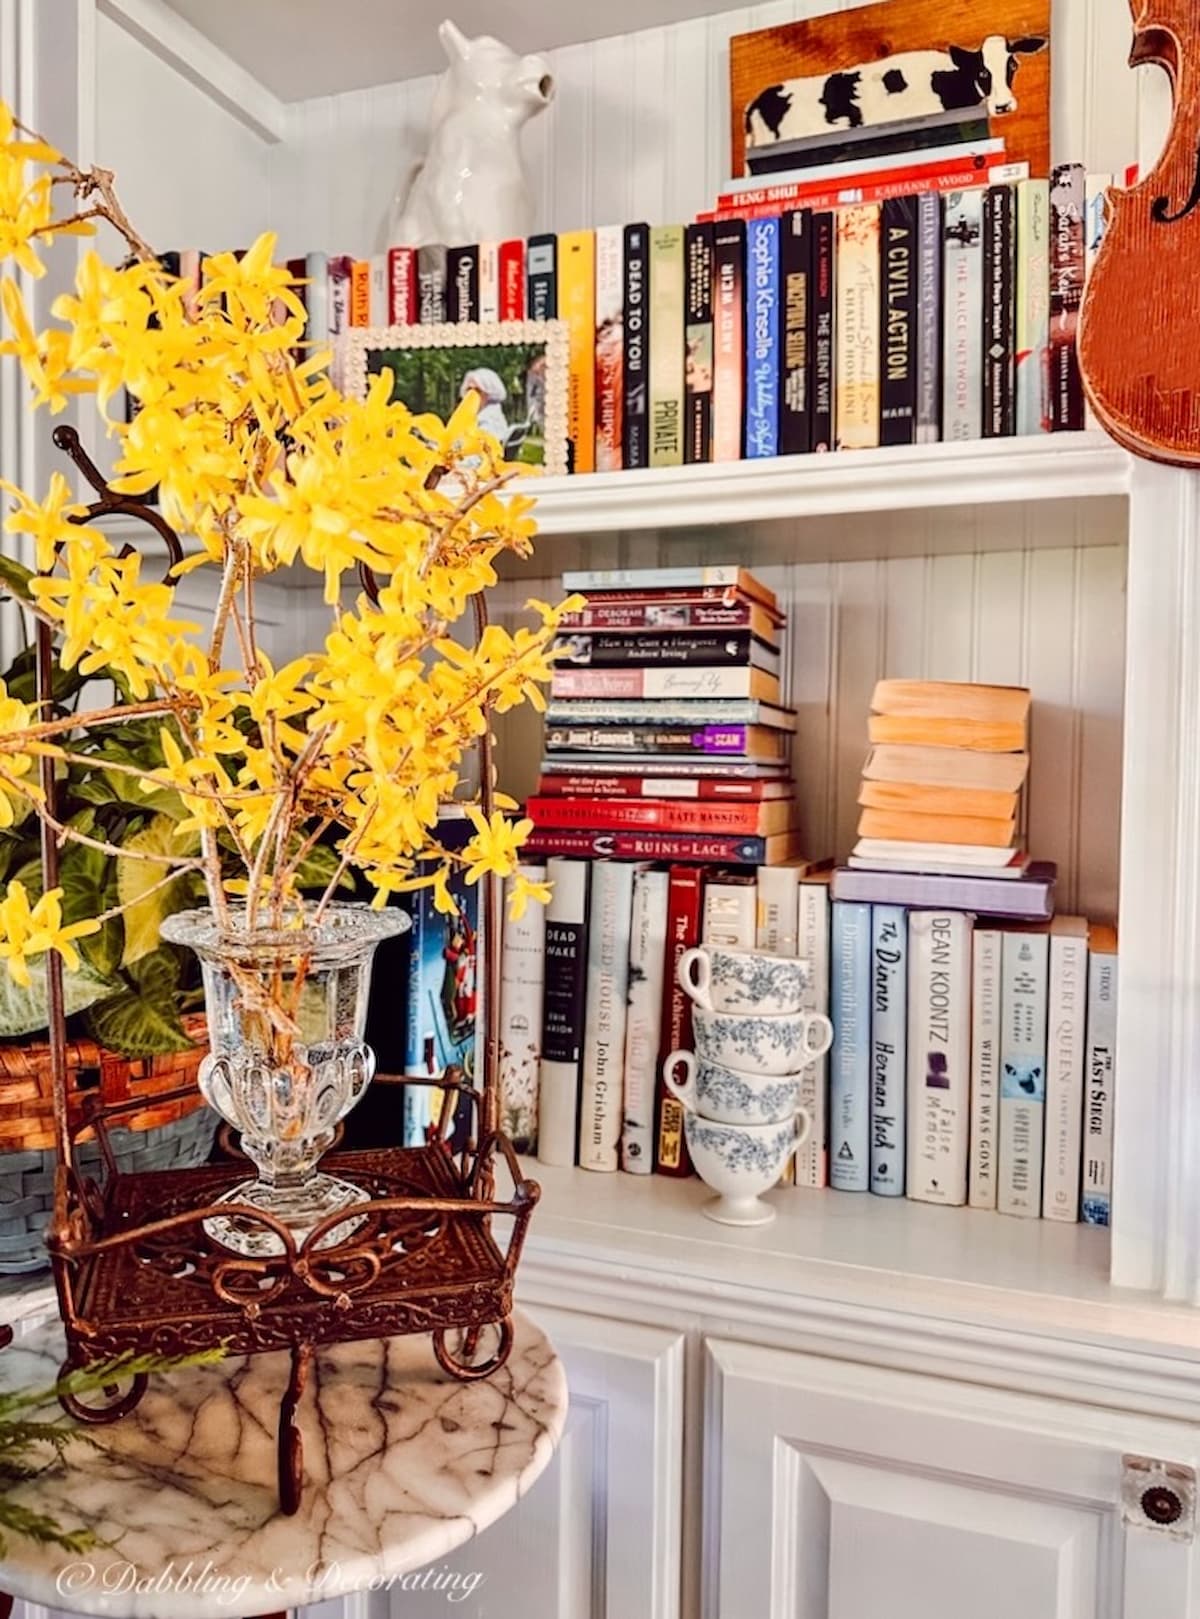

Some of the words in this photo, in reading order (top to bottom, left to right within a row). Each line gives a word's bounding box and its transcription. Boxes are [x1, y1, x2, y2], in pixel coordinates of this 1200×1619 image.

[767, 184, 798, 200] SHUI
[752, 224, 775, 286] Sophie
[889, 228, 909, 241] A
[629, 260, 641, 305] DEAD
[888, 247, 909, 304] CIVIL
[957, 258, 968, 281] THE
[629, 310, 641, 331] TO
[755, 291, 776, 359] Kinsella
[817, 313, 829, 331] THE
[957, 291, 968, 329] ALICE
[629, 335, 641, 371] YOU
[817, 340, 829, 379] SILENT
[888, 309, 909, 381] ACTION
[956, 340, 968, 409] NETWORK
[817, 385, 829, 413] WIFE
[654, 400, 678, 454] PRIVATE
[635, 841, 679, 854] RUINS
[692, 842, 728, 857] LACE
[546, 929, 577, 942] DEAD
[676, 915, 688, 940] The
[879, 922, 897, 942] The
[930, 918, 951, 965] DEAN
[546, 945, 577, 959] WAKE
[876, 948, 901, 1013] Dinner
[1060, 946, 1076, 1014] DESERT
[1100, 966, 1112, 1000] STROUD
[598, 972, 613, 1033] HOUSE
[929, 971, 950, 1043] KOONTZ
[596, 1039, 610, 1076] John
[980, 1039, 992, 1087] WHILE
[1057, 1019, 1073, 1082] QUEEN
[1091, 1045, 1109, 1088] LAST
[874, 1041, 895, 1107] Herman
[594, 1081, 609, 1146] Grisham
[874, 1115, 896, 1150] Koch
[923, 1096, 941, 1161] Memory
[940, 1108, 956, 1153] False
[980, 1105, 991, 1133] WAS
[1089, 1090, 1108, 1135] SIEGE
[979, 1139, 991, 1180] GONE
